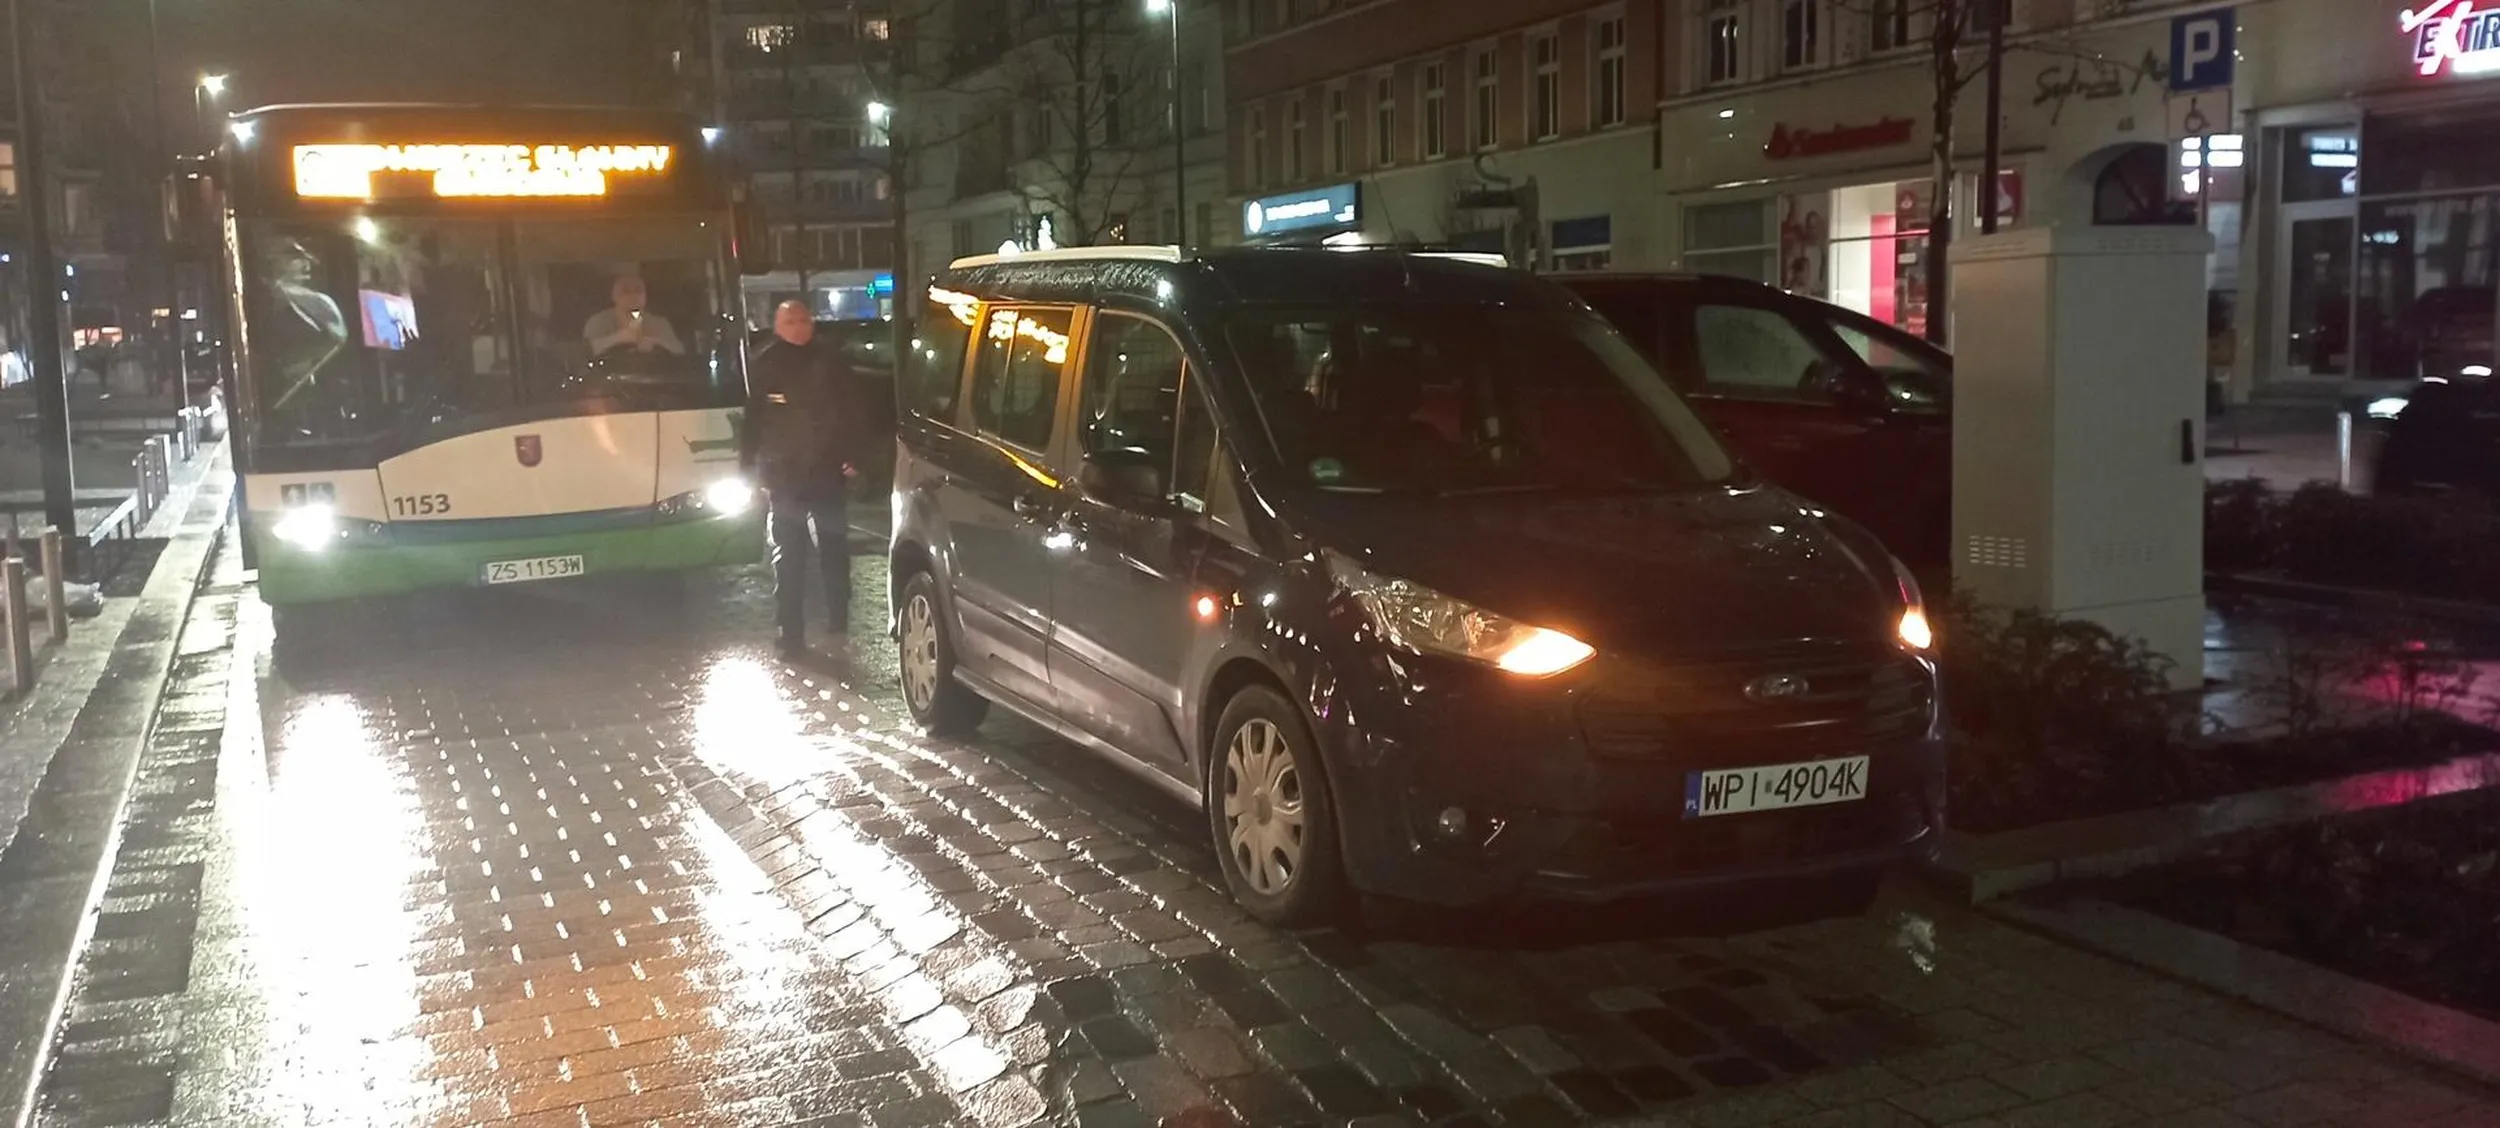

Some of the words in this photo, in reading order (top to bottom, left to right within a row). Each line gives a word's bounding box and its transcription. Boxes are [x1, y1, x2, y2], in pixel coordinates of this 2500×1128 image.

[2183, 19, 2219, 81] P
[393, 494, 451, 516] 1153
[490, 563, 519, 582] ZS
[525, 556, 582, 577] 1153W
[1704, 771, 1759, 811] WPI
[1774, 760, 1865, 803] 4904K
